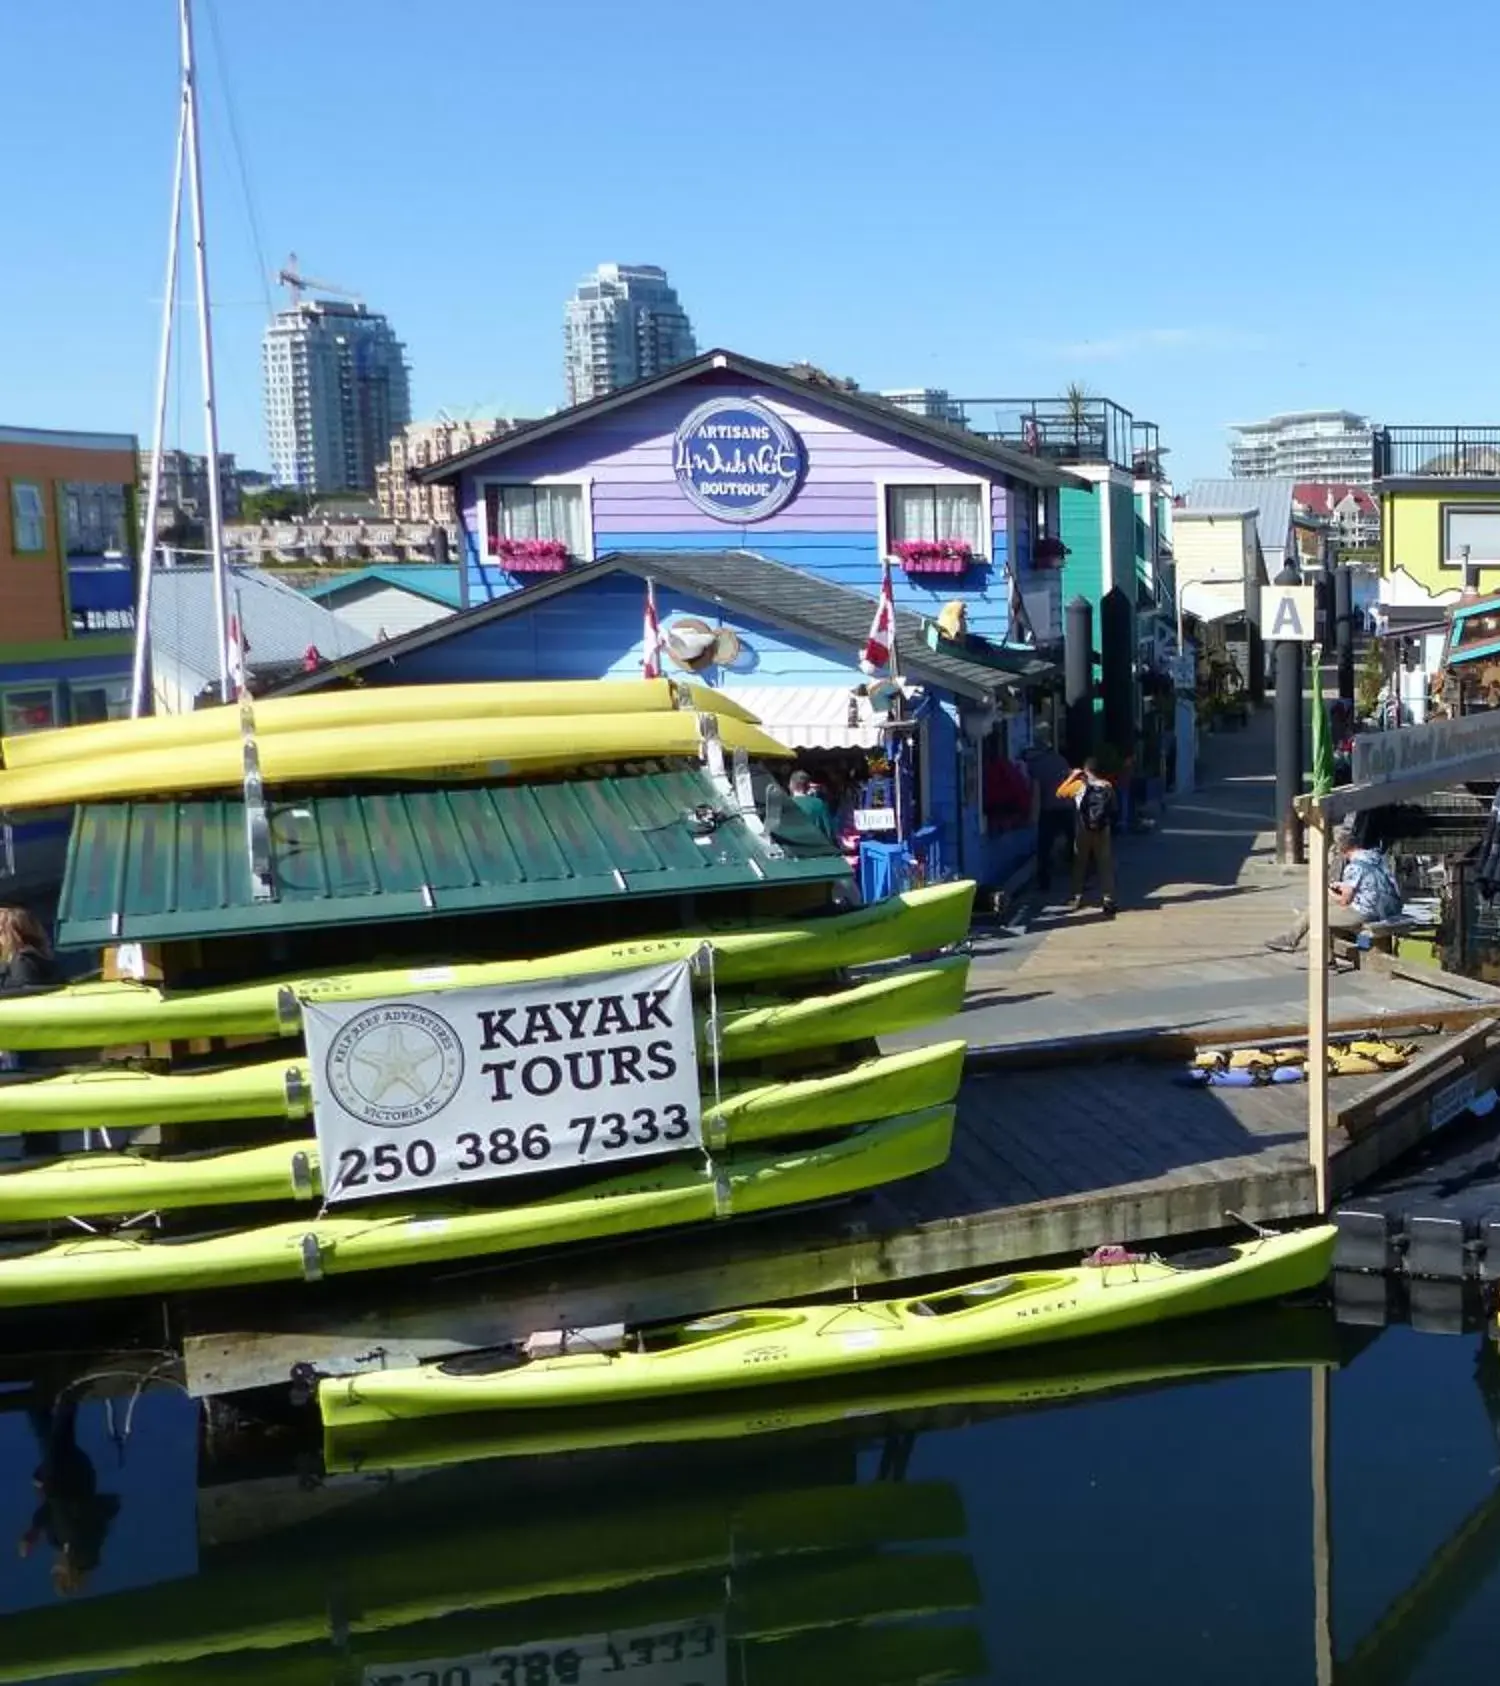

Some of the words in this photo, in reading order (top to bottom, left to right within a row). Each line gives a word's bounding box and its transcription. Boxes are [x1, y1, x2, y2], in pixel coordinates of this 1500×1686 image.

[699, 425, 770, 439] ARTISANS
[701, 482, 771, 497] BOUTIQUE
[1272, 597, 1304, 634] A
[612, 941, 682, 957] NECKY
[385, 1011, 454, 1051] ADVENTURES
[477, 989, 673, 1050] KAYAK
[480, 1040, 677, 1102] TOURS
[364, 1105, 423, 1121] VICTORIA
[423, 1096, 440, 1110] BC
[339, 1139, 437, 1188] 250
[456, 1123, 552, 1171] 386
[569, 1103, 691, 1155] 7333
[1017, 1299, 1077, 1316] NECKY
